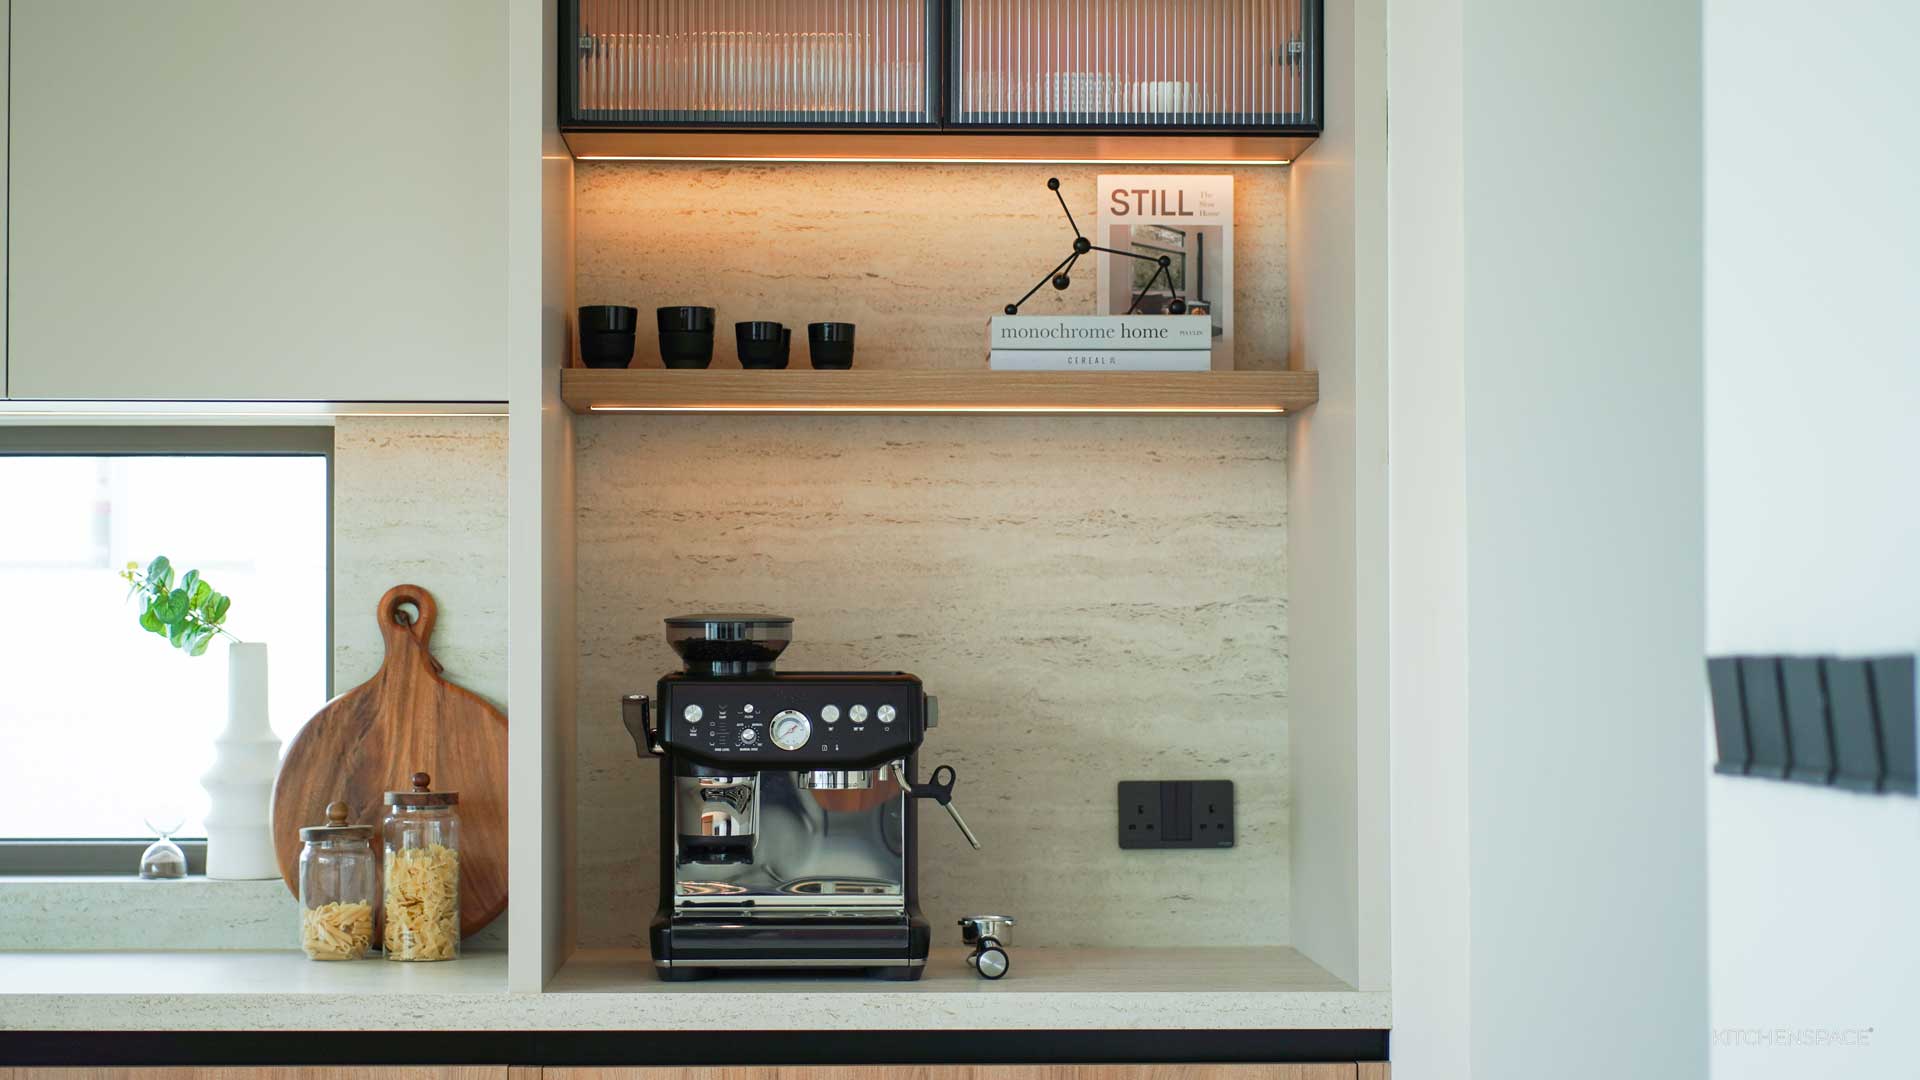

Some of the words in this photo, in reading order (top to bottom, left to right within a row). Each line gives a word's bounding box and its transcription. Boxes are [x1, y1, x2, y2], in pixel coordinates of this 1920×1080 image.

[1110, 188, 1194, 216] STILL
[1001, 323, 1116, 339] monochrome
[1121, 323, 1168, 339] home
[1067, 356, 1105, 365] CEREAL
